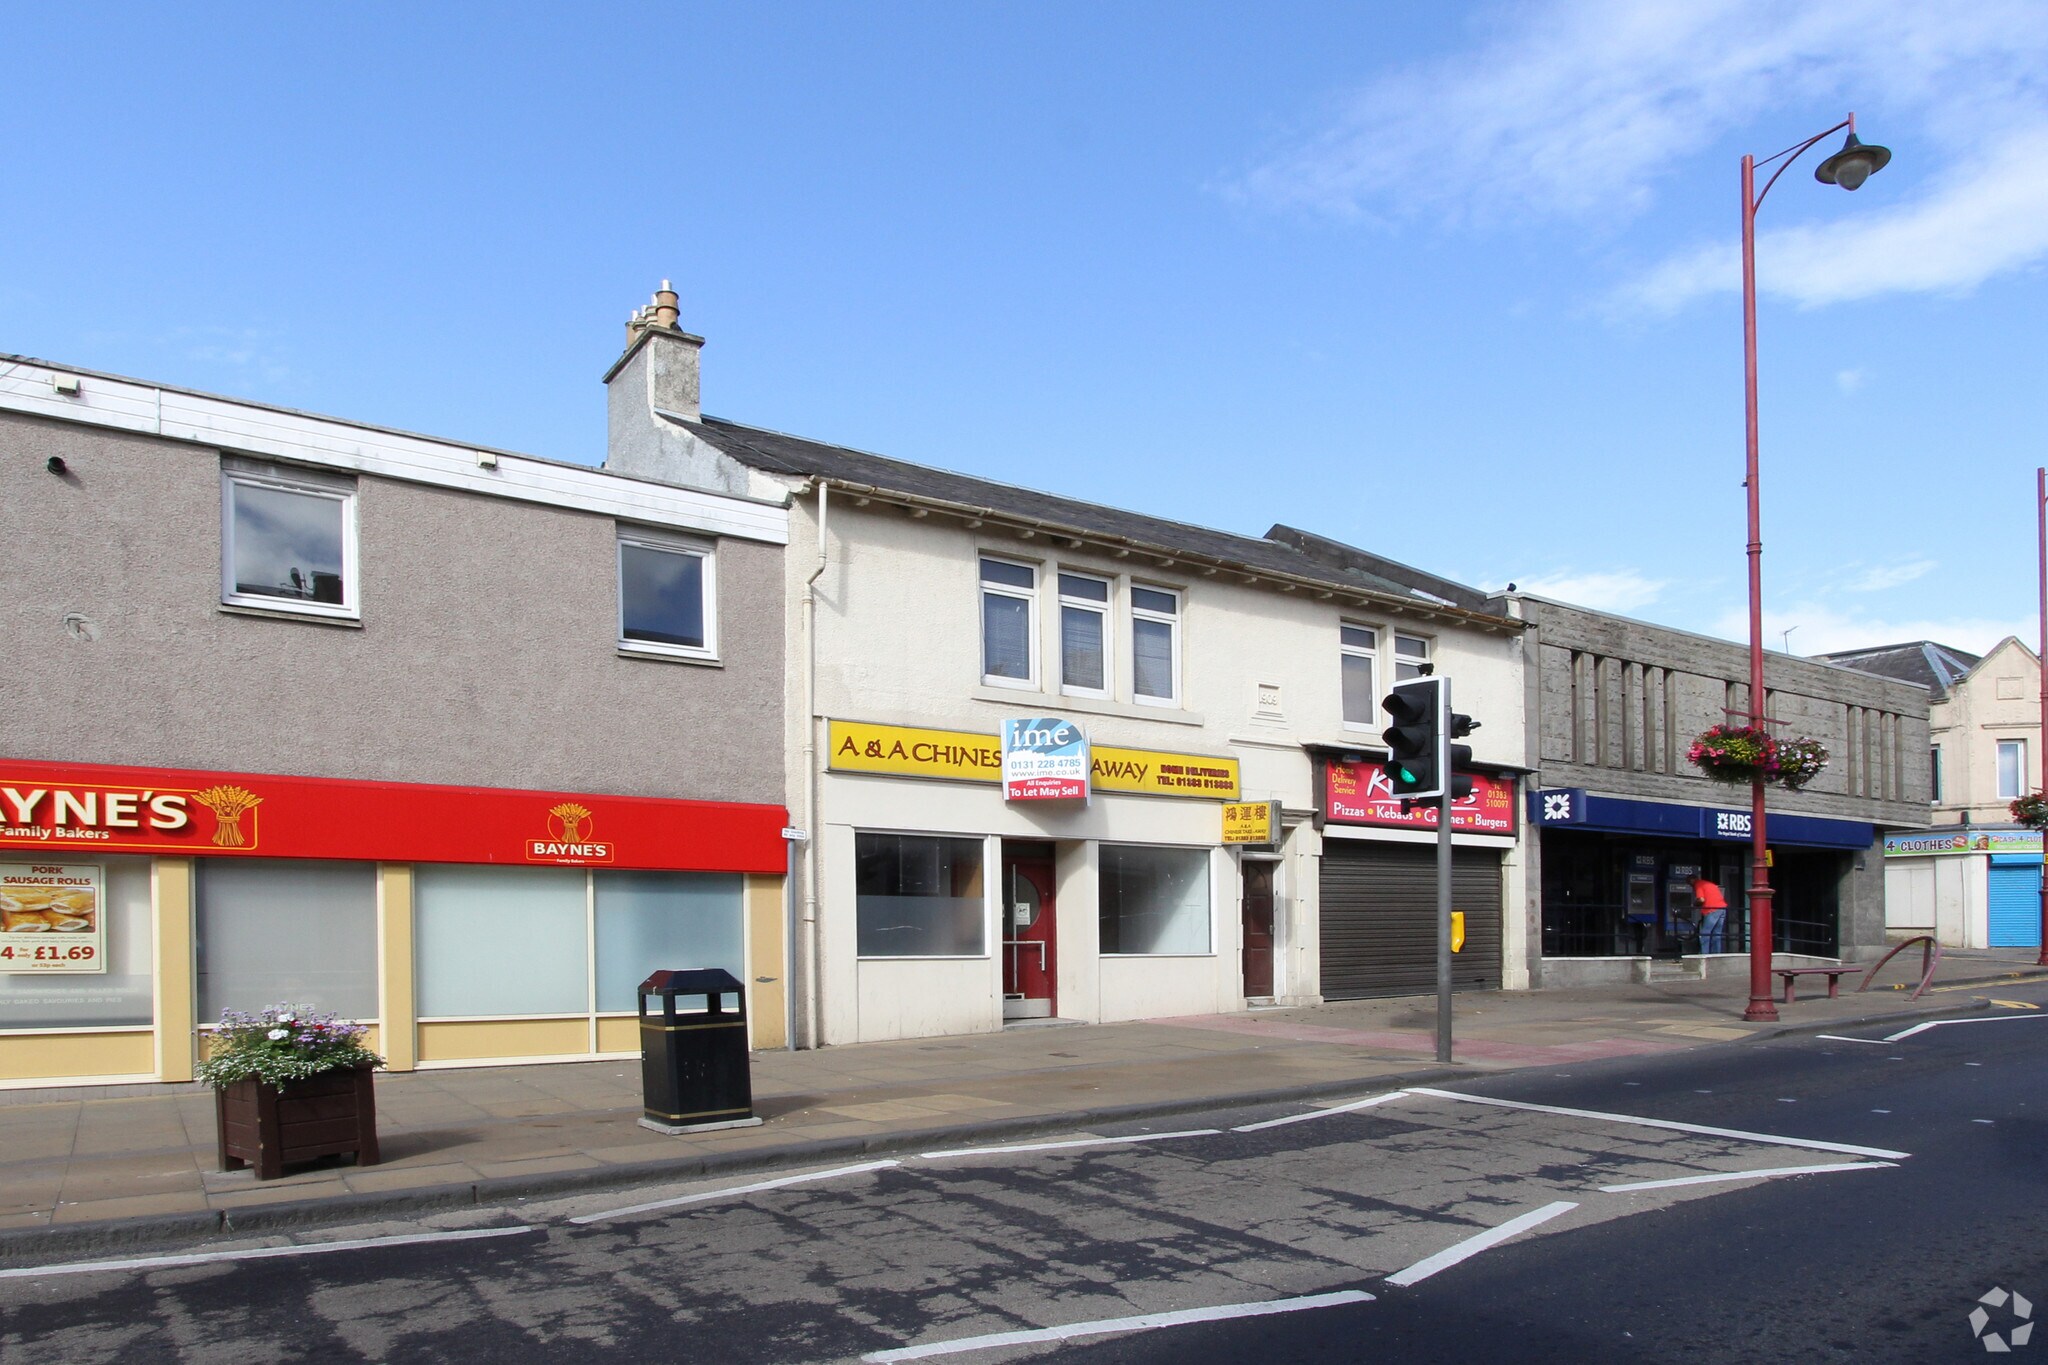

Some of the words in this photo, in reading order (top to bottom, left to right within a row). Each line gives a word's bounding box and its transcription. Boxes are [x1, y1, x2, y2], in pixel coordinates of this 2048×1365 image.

[1012, 722, 1070, 748] ime
[838, 735, 860, 756] A
[864, 739, 885, 758] &
[888, 740, 909, 760] A
[912, 743, 1003, 768] CHINES
[1011, 760, 1034, 770] 0131
[1037, 760, 1055, 769] 228
[1057, 759, 1081, 768] 4785
[1011, 768, 1081, 777] www.ime.co.uk
[1331, 773, 1357, 787] Delivery
[1010, 788, 1021, 797] To
[1023, 788, 1038, 797] Let
[1039, 788, 1060, 798] May
[1061, 786, 1079, 796] Sell
[1333, 783, 1356, 795] Service
[1487, 789, 1507, 800] 01383
[0, 787, 188, 829] YNE'S
[1485, 799, 1509, 809] 510097
[1333, 801, 1365, 817] Pizzas
[1424, 810, 1465, 825] Canes
[1475, 813, 1508, 829] Burgers
[1729, 813, 1751, 832] RBS
[55, 827, 110, 840] Bakers
[533, 842, 607, 857] BAYNE'S
[1886, 840, 1896, 852] 4
[1900, 839, 1952, 851] CLOTHES
[31, 866, 64, 875] PORK
[3, 876, 55, 885] SAUSAGE
[57, 877, 91, 886] ROLLS
[0, 946, 15, 960] 4
[34, 946, 95, 960] £1.69
